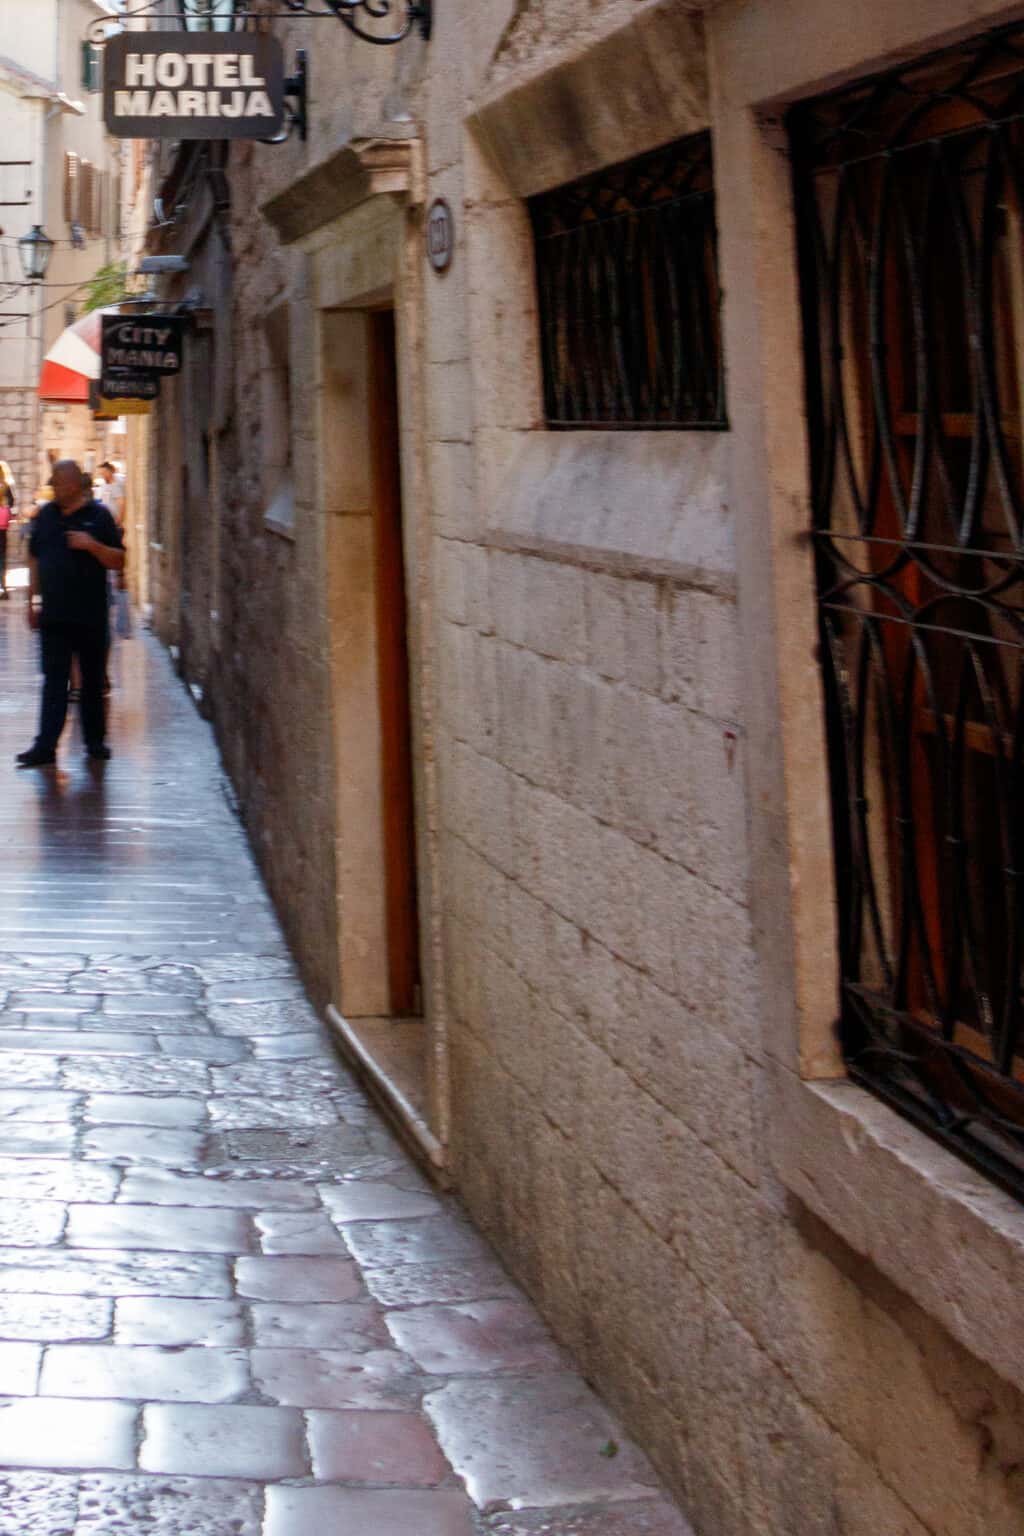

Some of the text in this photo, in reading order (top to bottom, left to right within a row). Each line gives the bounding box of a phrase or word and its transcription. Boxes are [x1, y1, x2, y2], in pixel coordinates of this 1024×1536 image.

[125, 52, 266, 88] HOTEL
[113, 90, 275, 118] MARIJA
[118, 325, 173, 345] CITY
